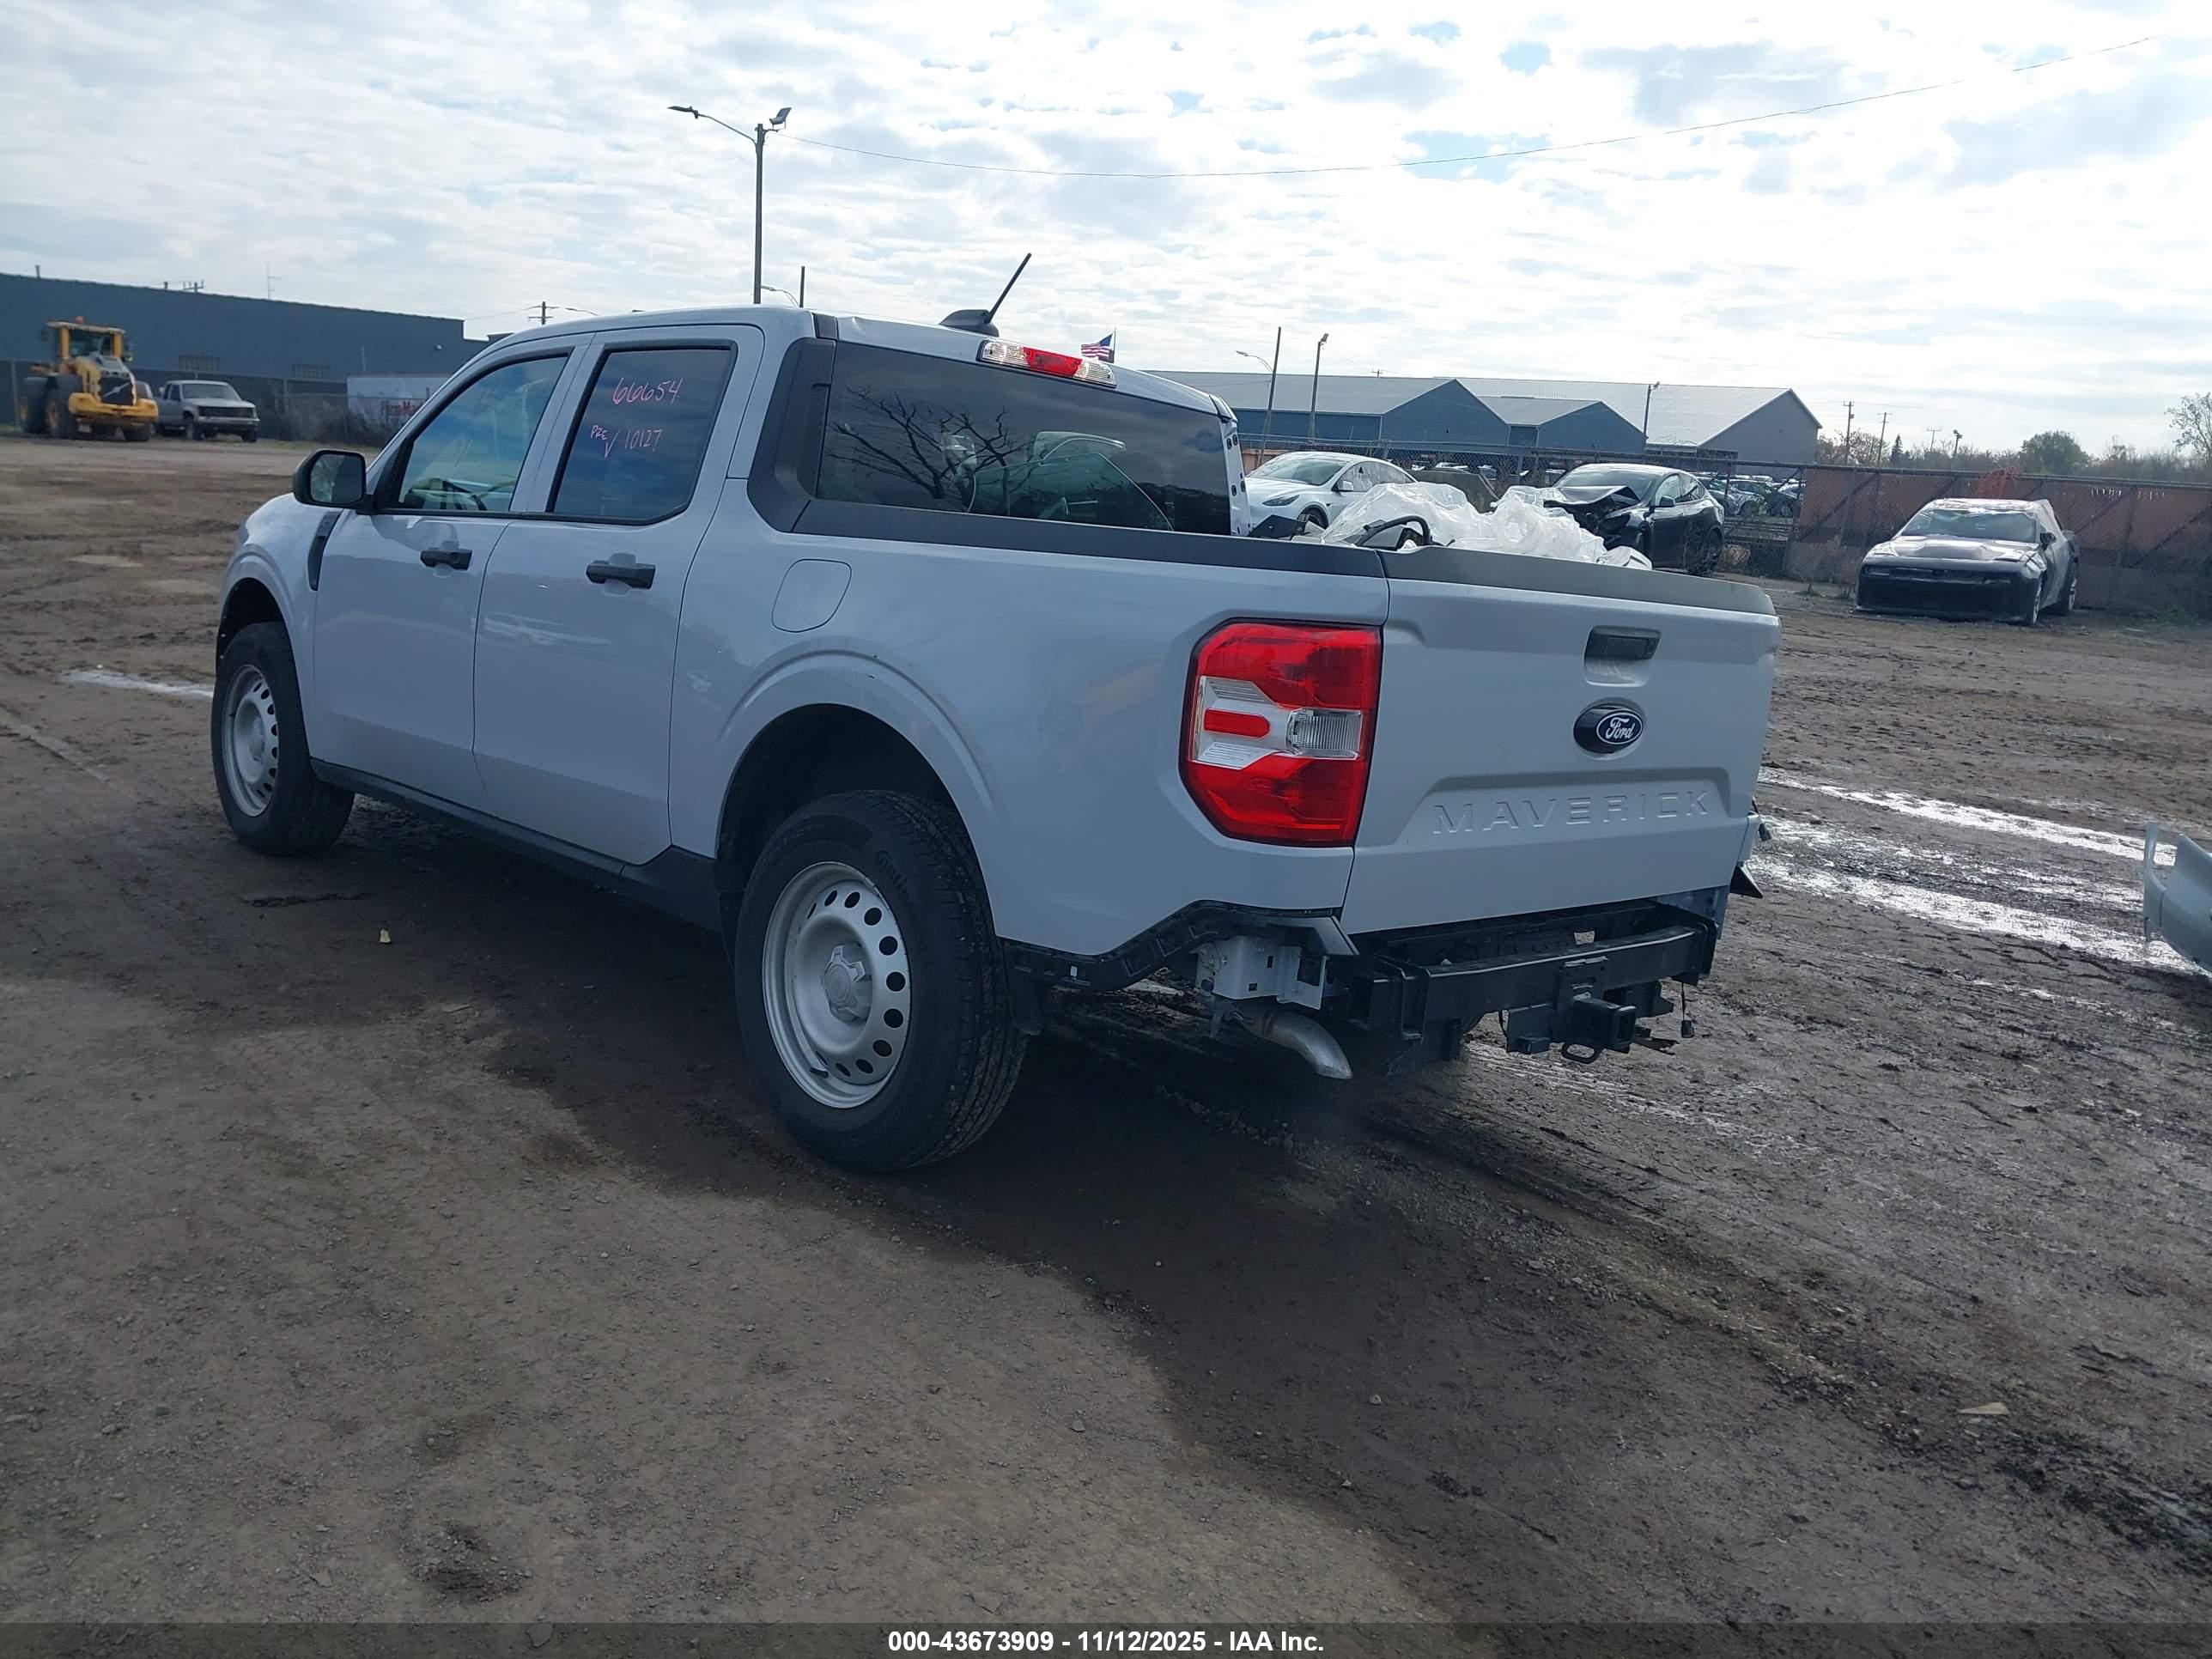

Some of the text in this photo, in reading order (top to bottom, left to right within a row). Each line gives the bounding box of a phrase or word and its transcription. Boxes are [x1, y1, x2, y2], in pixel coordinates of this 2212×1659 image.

[612, 378, 684, 404] 66654
[625, 428, 662, 452] 10127
[1605, 716, 1634, 740] Ford
[1433, 790, 1709, 836] MAVERICK
